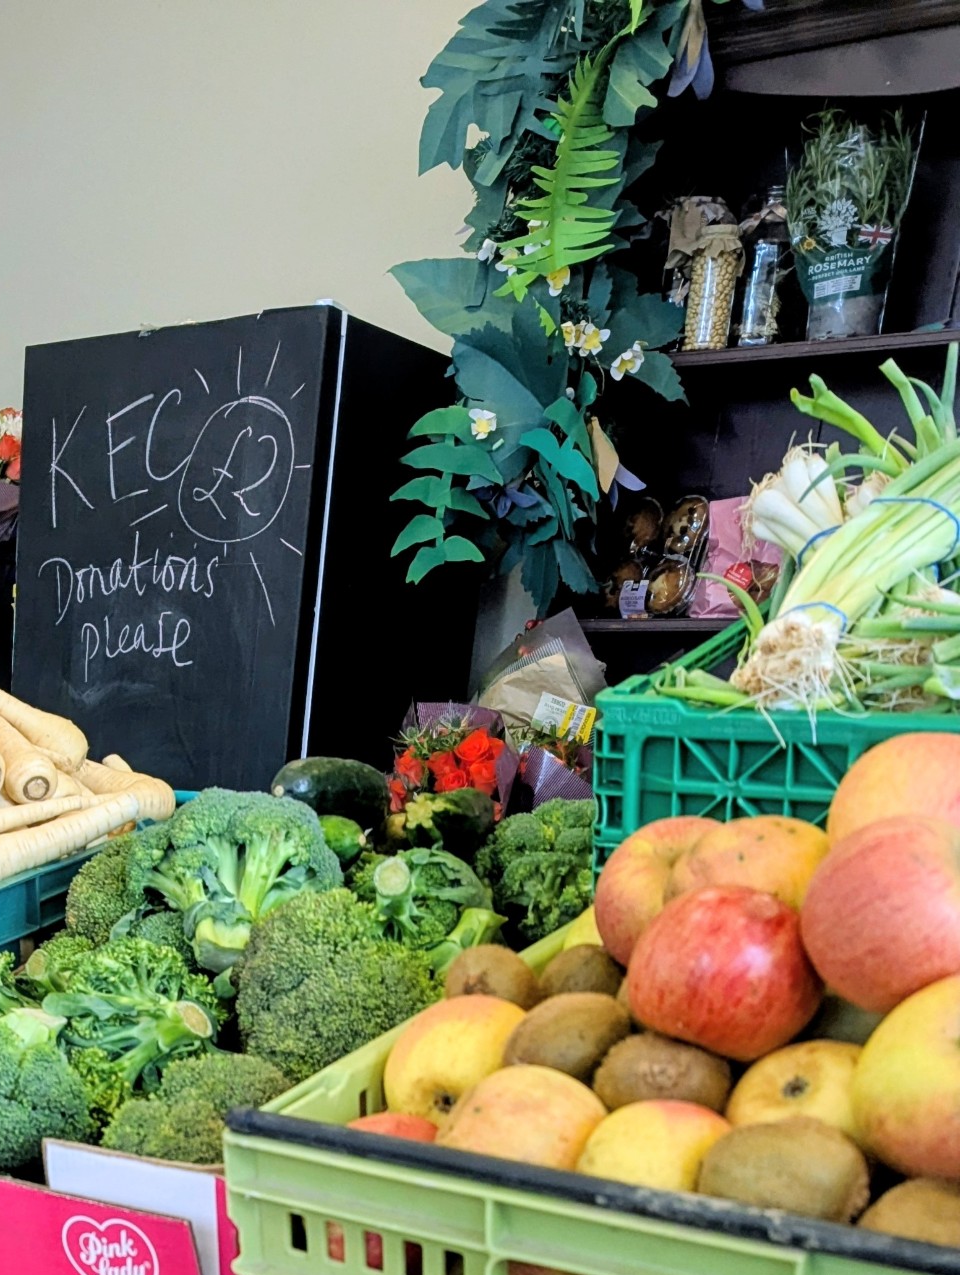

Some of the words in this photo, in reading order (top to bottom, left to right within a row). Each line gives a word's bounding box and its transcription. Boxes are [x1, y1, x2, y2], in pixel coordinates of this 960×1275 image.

[808, 254, 872, 275] ROSEMARY
[192, 426, 278, 520] £2
[38, 531, 218, 625] Donations
[79, 1229, 138, 1265] Pink
